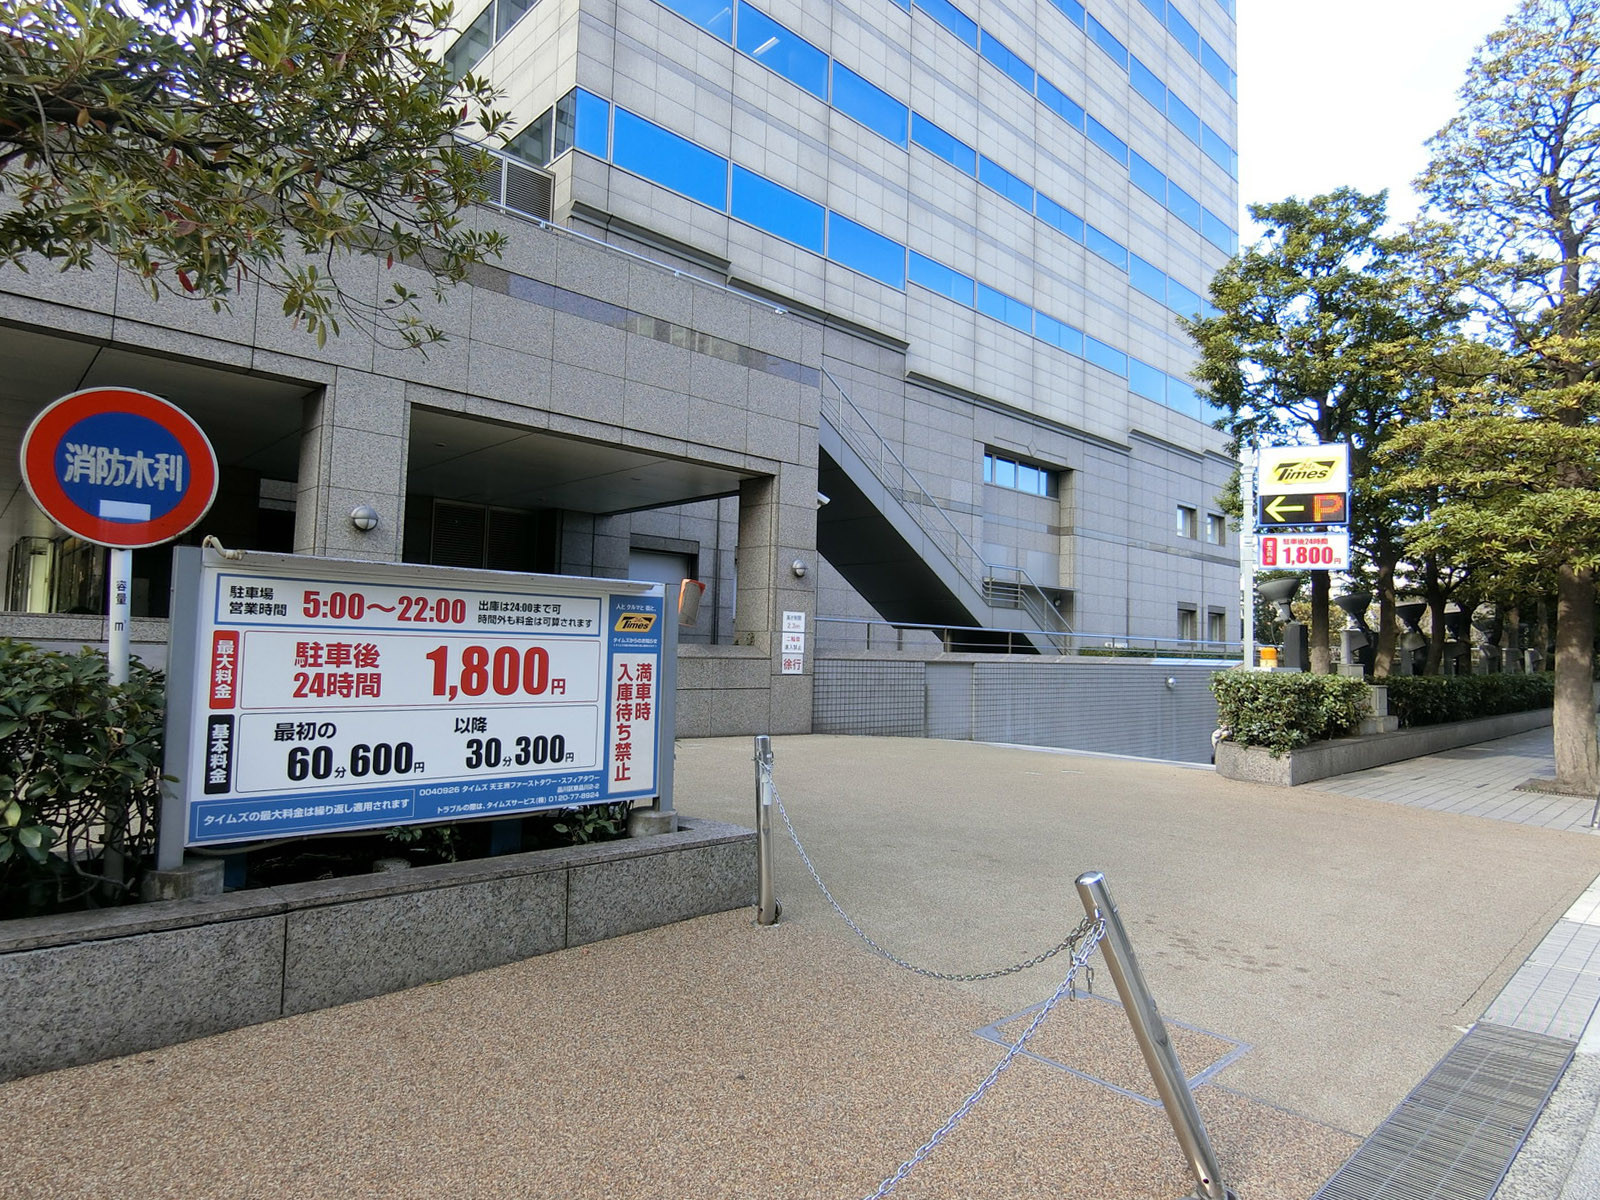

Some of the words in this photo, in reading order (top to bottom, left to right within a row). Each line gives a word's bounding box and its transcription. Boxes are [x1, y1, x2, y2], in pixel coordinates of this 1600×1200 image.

[64, 442, 182, 492] 消防水利
[1274, 460, 1335, 481] Times
[1313, 494, 1344, 522] P
[116, 580, 127, 605] 容量
[229, 585, 274, 600] 駐車場
[229, 601, 287, 617] 営業時間
[478, 600, 561, 615] 出庫は24:00まで可
[621, 616, 653, 630] Times
[294, 641, 381, 669] 駐車後
[783, 658, 802, 671] 徐行
[214, 639, 234, 700] 最大料金
[293, 672, 382, 699] 24時間
[634, 662, 652, 721] 満車時
[274, 721, 337, 742] 最初の
[454, 717, 488, 734] 以降
[614, 663, 634, 782] 入庫待ち禁止
[209, 724, 230, 784] 基本料金
[419, 786, 460, 797] 0040926
[462, 783, 488, 793] タイムズ
[204, 799, 410, 826] タイムズの最大料金は繰り返し適用されます
